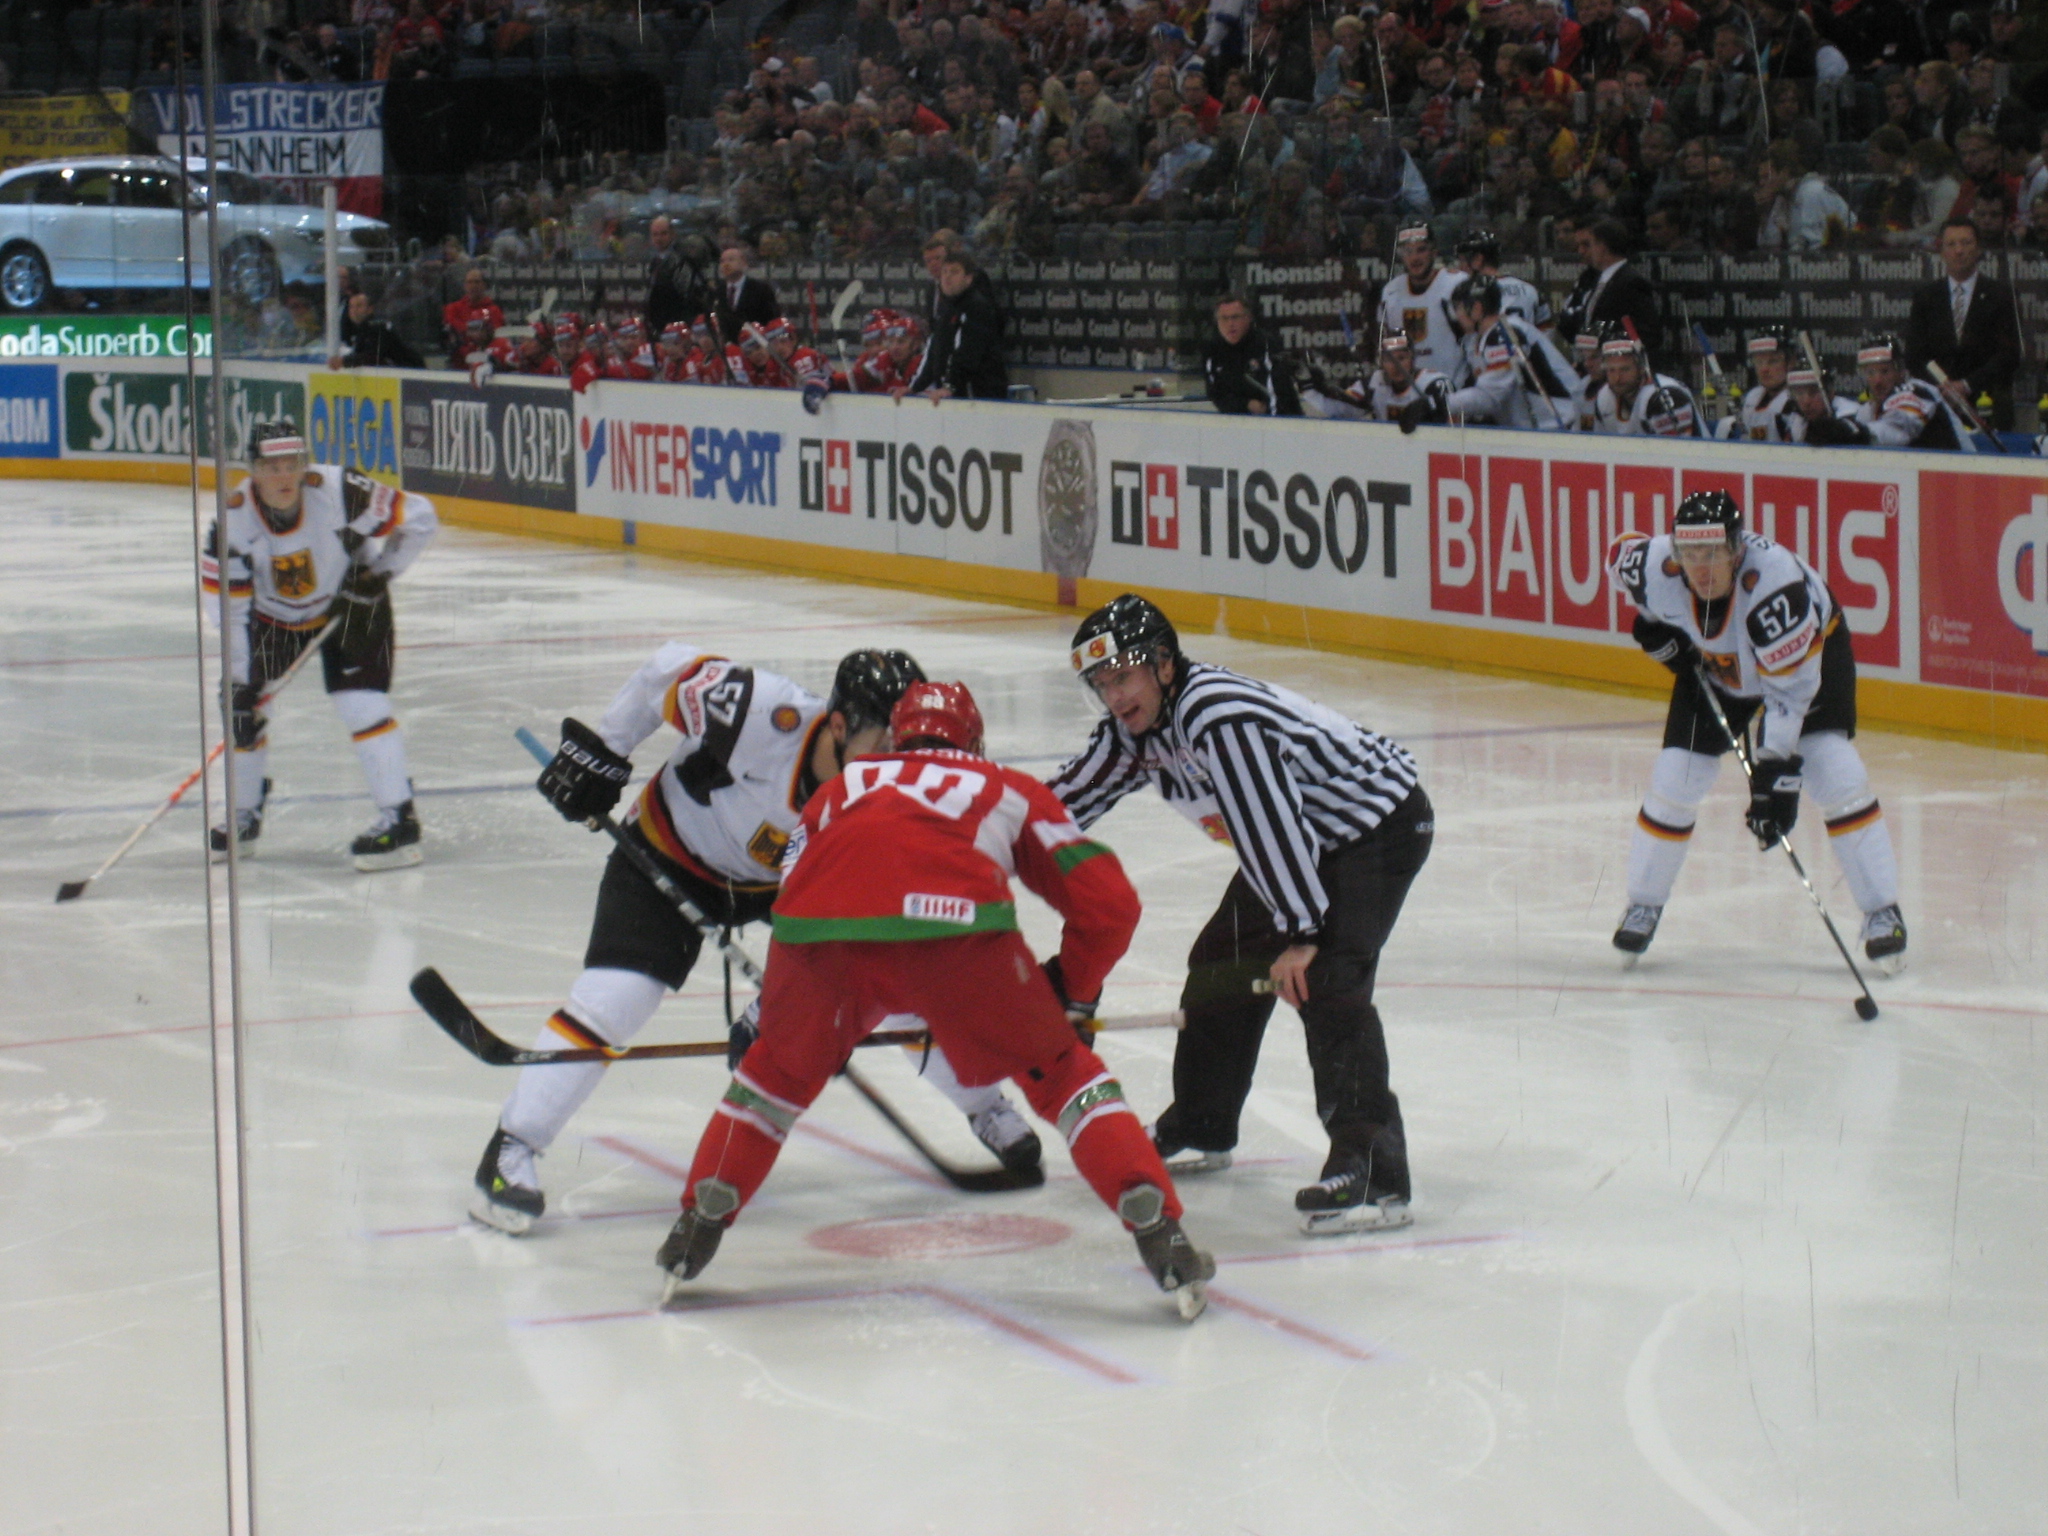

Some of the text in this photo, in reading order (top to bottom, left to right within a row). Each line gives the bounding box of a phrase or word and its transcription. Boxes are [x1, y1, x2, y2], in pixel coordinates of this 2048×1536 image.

[191, 137, 345, 174] ANNHEIM
[1246, 257, 1344, 286] Thomsit
[1259, 288, 1364, 318] Thomsit
[431, 399, 573, 486] ПЯТЬ ОЗЕР
[610, 418, 783, 507] INTERSPORT
[856, 440, 1023, 536] TISSOT
[1186, 466, 1412, 579] TISSOT
[1437, 477, 1893, 635] BAUS
[1757, 592, 1799, 639] 52
[923, 896, 971, 917] IIHF
